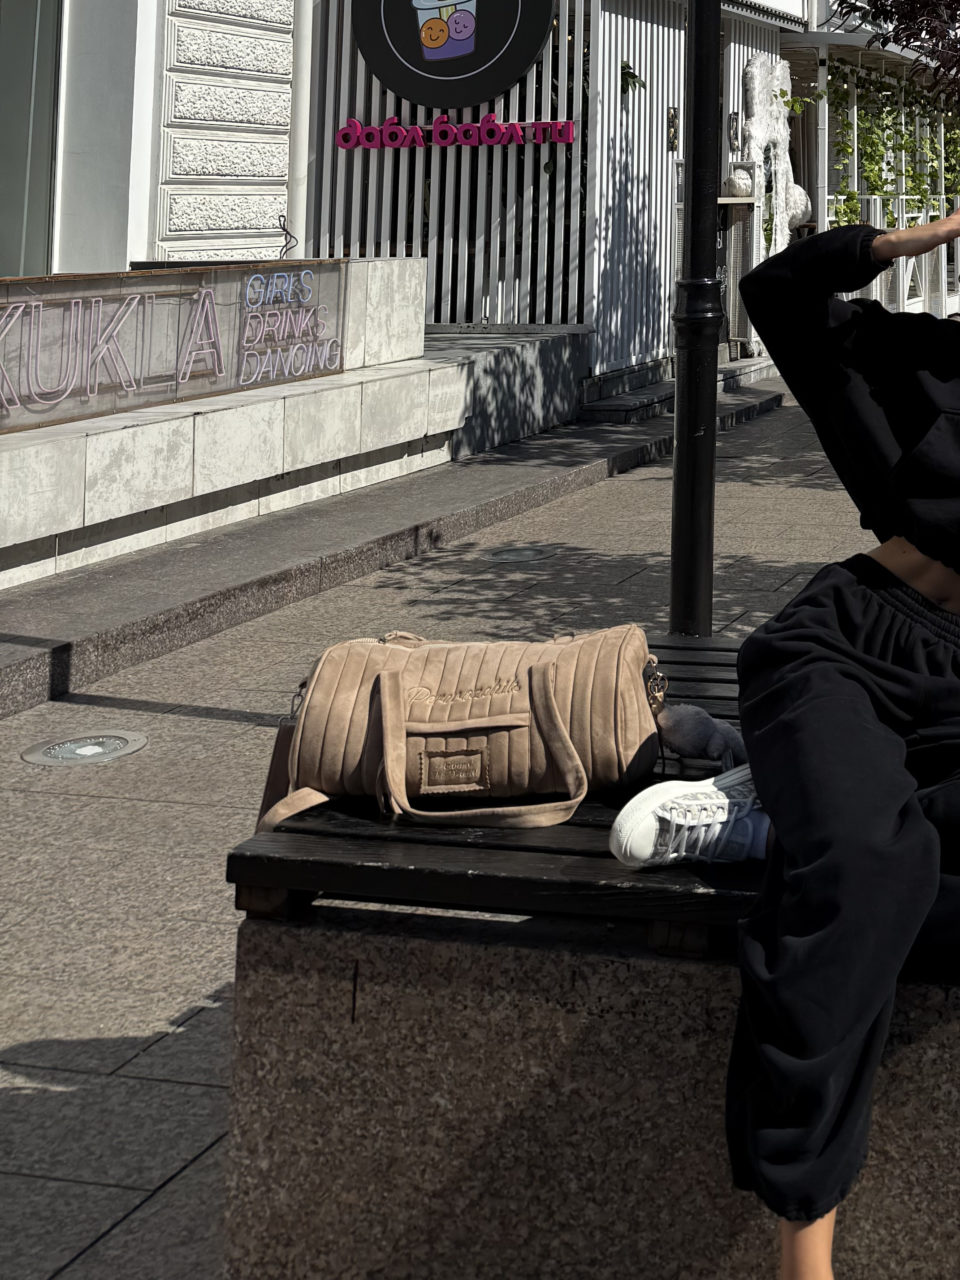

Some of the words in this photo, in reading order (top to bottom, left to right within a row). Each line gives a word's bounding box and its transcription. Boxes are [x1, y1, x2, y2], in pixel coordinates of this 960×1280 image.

[336, 117, 427, 150] дабл
[432, 113, 525, 147] бабл
[246, 270, 314, 308] GIRLS
[243, 304, 329, 346] DRINKS
[240, 338, 340, 385] DANCING
